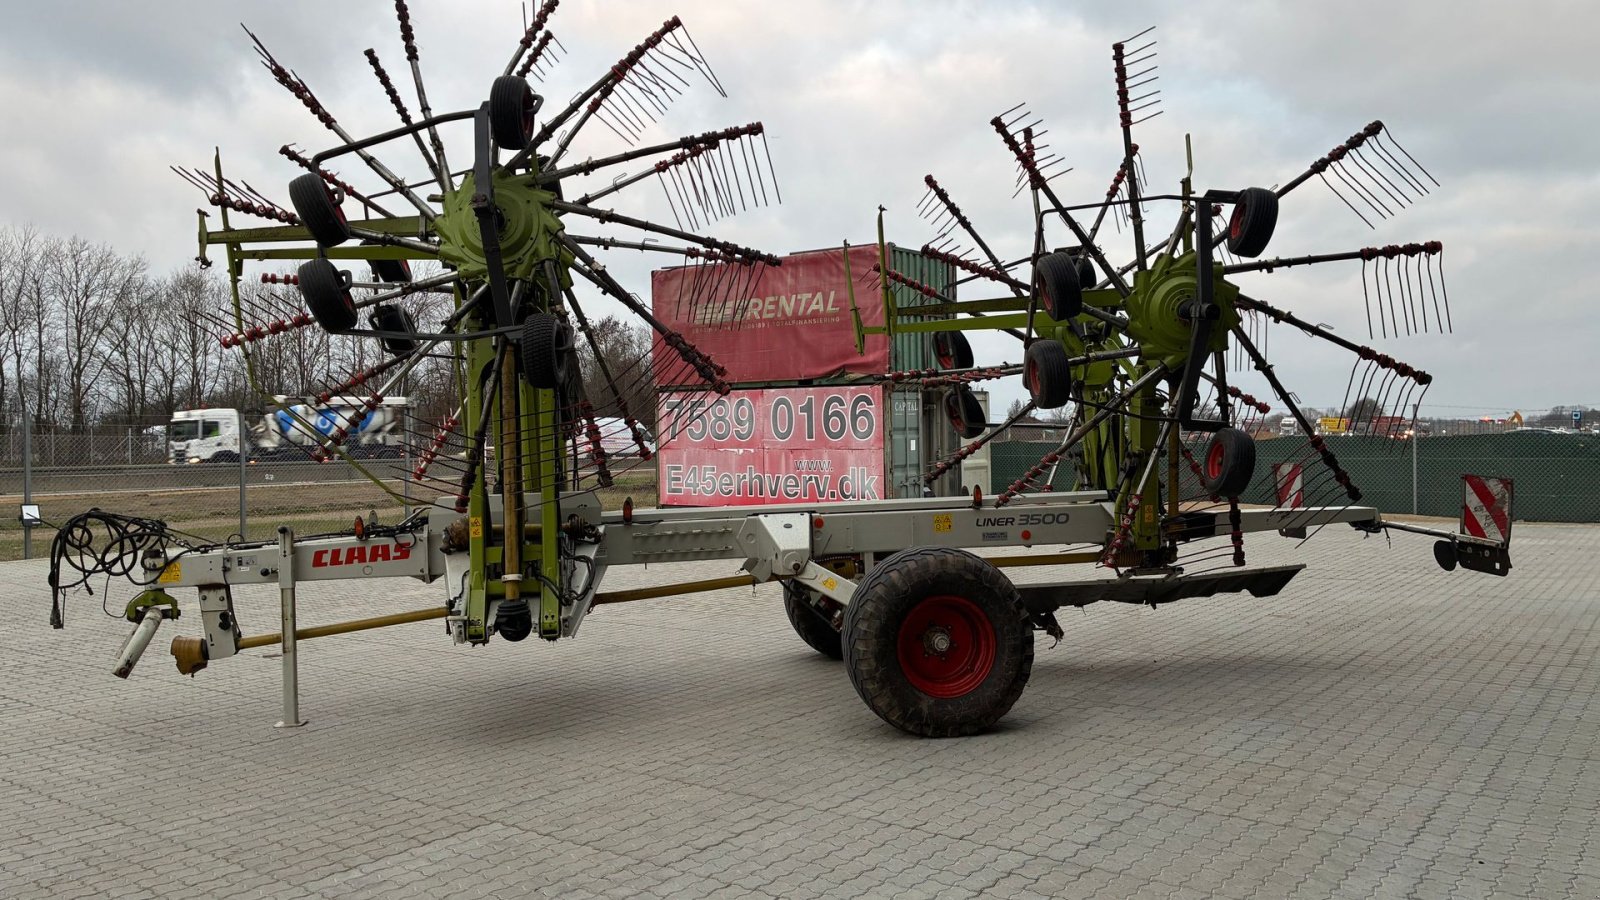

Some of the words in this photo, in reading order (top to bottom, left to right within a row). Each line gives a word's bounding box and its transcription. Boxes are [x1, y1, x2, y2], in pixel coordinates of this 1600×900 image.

[894, 401, 918, 411] CAPTAL
[666, 396, 755, 441] 7589
[770, 394, 875, 441] 0166
[794, 460, 833, 471] www.
[666, 465, 879, 500] E45erhverv.dk
[976, 517, 1015, 527] LINER
[1018, 513, 1070, 525] 3500
[312, 542, 411, 568] CLAAS
